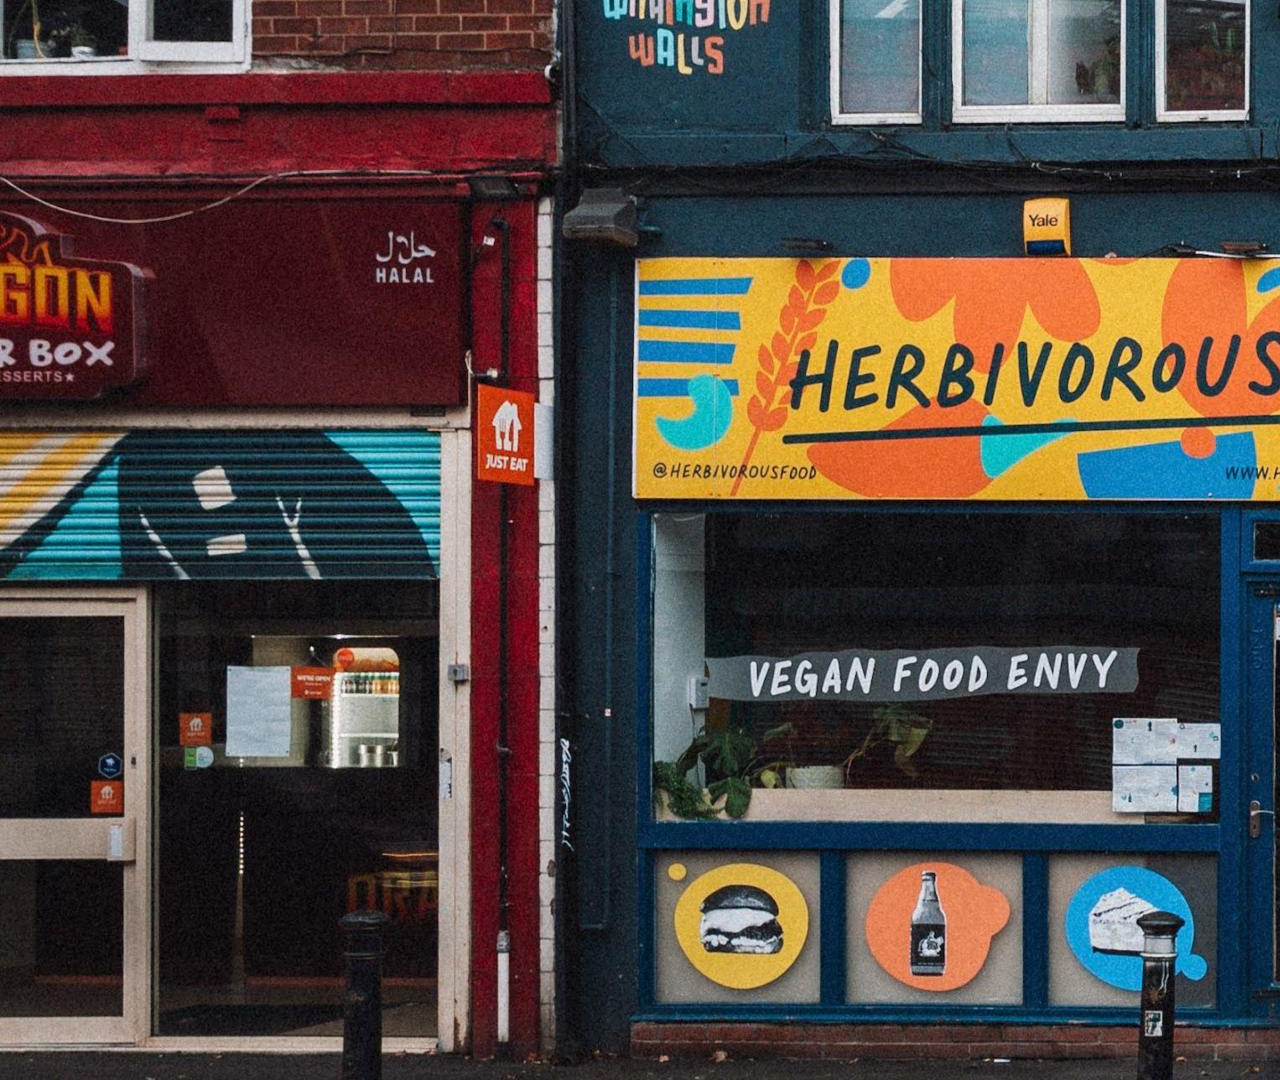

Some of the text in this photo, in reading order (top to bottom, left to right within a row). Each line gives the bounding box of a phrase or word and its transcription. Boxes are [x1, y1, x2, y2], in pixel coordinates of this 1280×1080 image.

[1029, 213, 1058, 229] Yale
[375, 231, 437, 265] حلال
[376, 267, 434, 284] HALAL
[29, 338, 115, 368] BOX
[0, 371, 63, 383] SSERTS
[485, 454, 528, 472] JUST EAT
[653, 462, 817, 481] @HERBIVOROUSFOOD
[750, 650, 1118, 697] VEGAN FOOD ENVY
